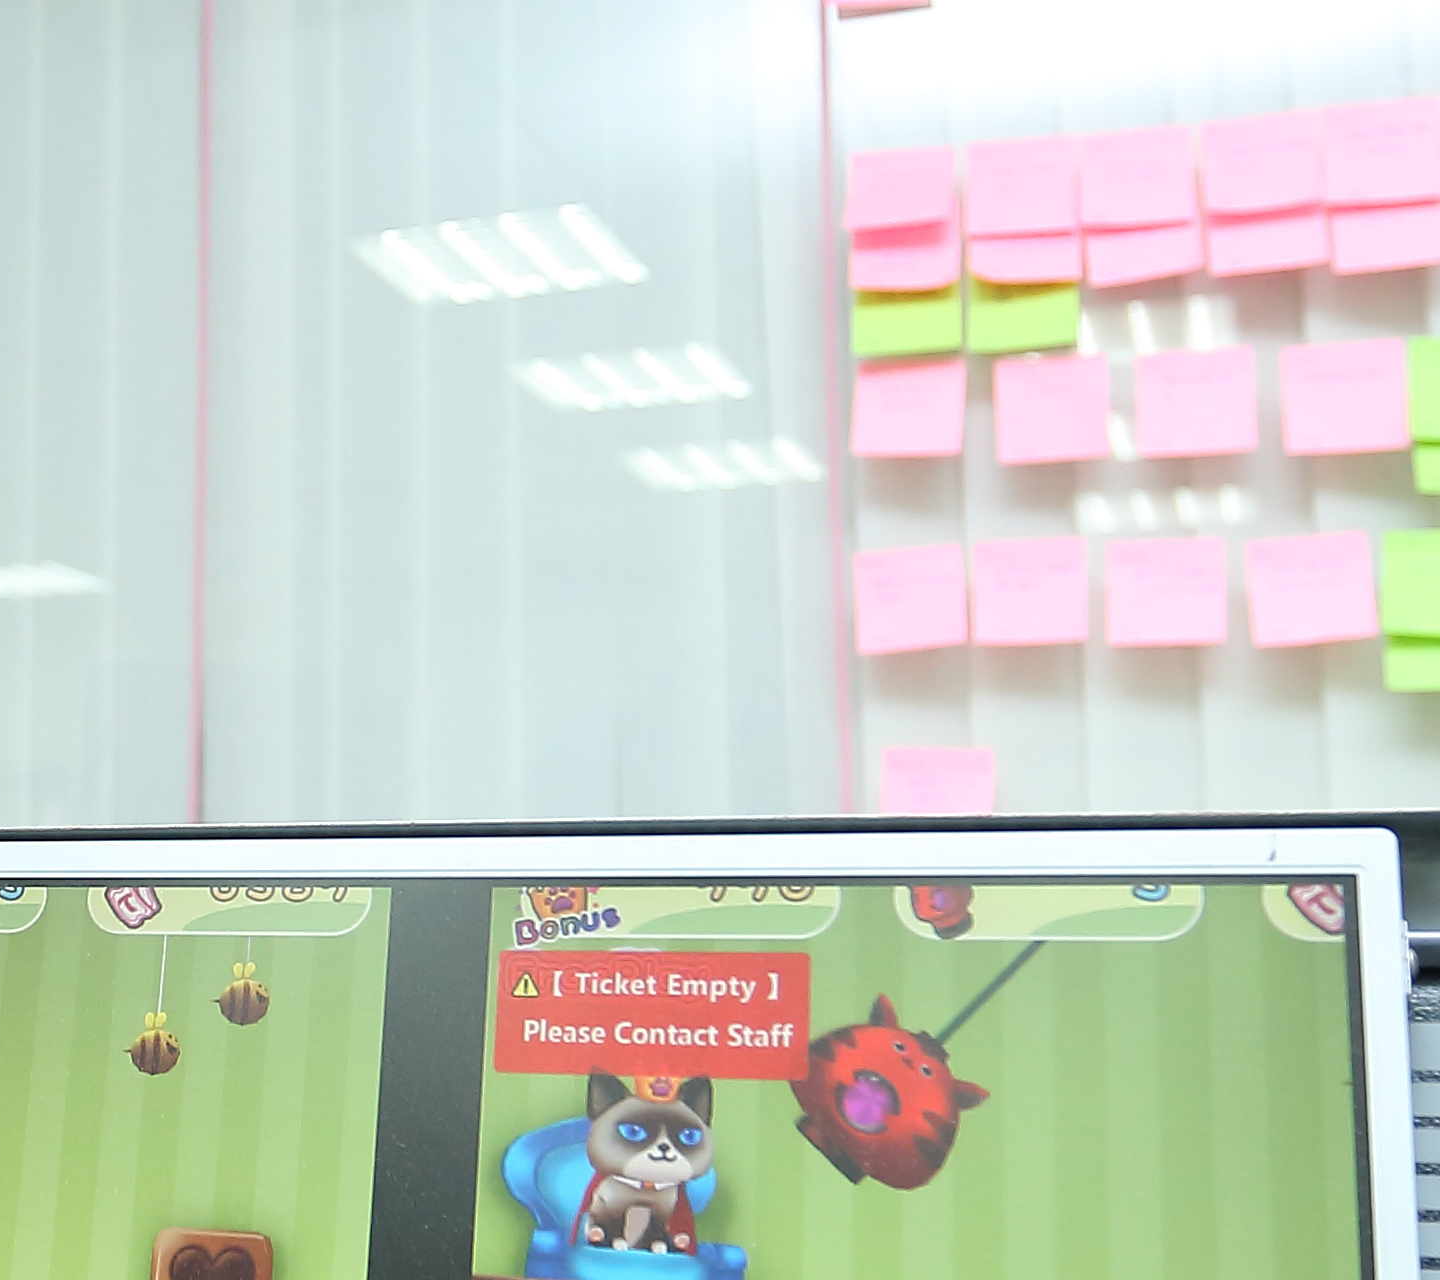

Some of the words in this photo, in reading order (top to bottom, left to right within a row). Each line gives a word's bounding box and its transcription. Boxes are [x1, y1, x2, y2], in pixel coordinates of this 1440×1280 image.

[514, 907, 622, 947] Bonus
[574, 971, 658, 997] Ticket
[668, 974, 757, 1004] Empty
[522, 1018, 607, 1045] Please
[613, 1021, 719, 1048] Contact
[726, 1022, 795, 1049] Staff
